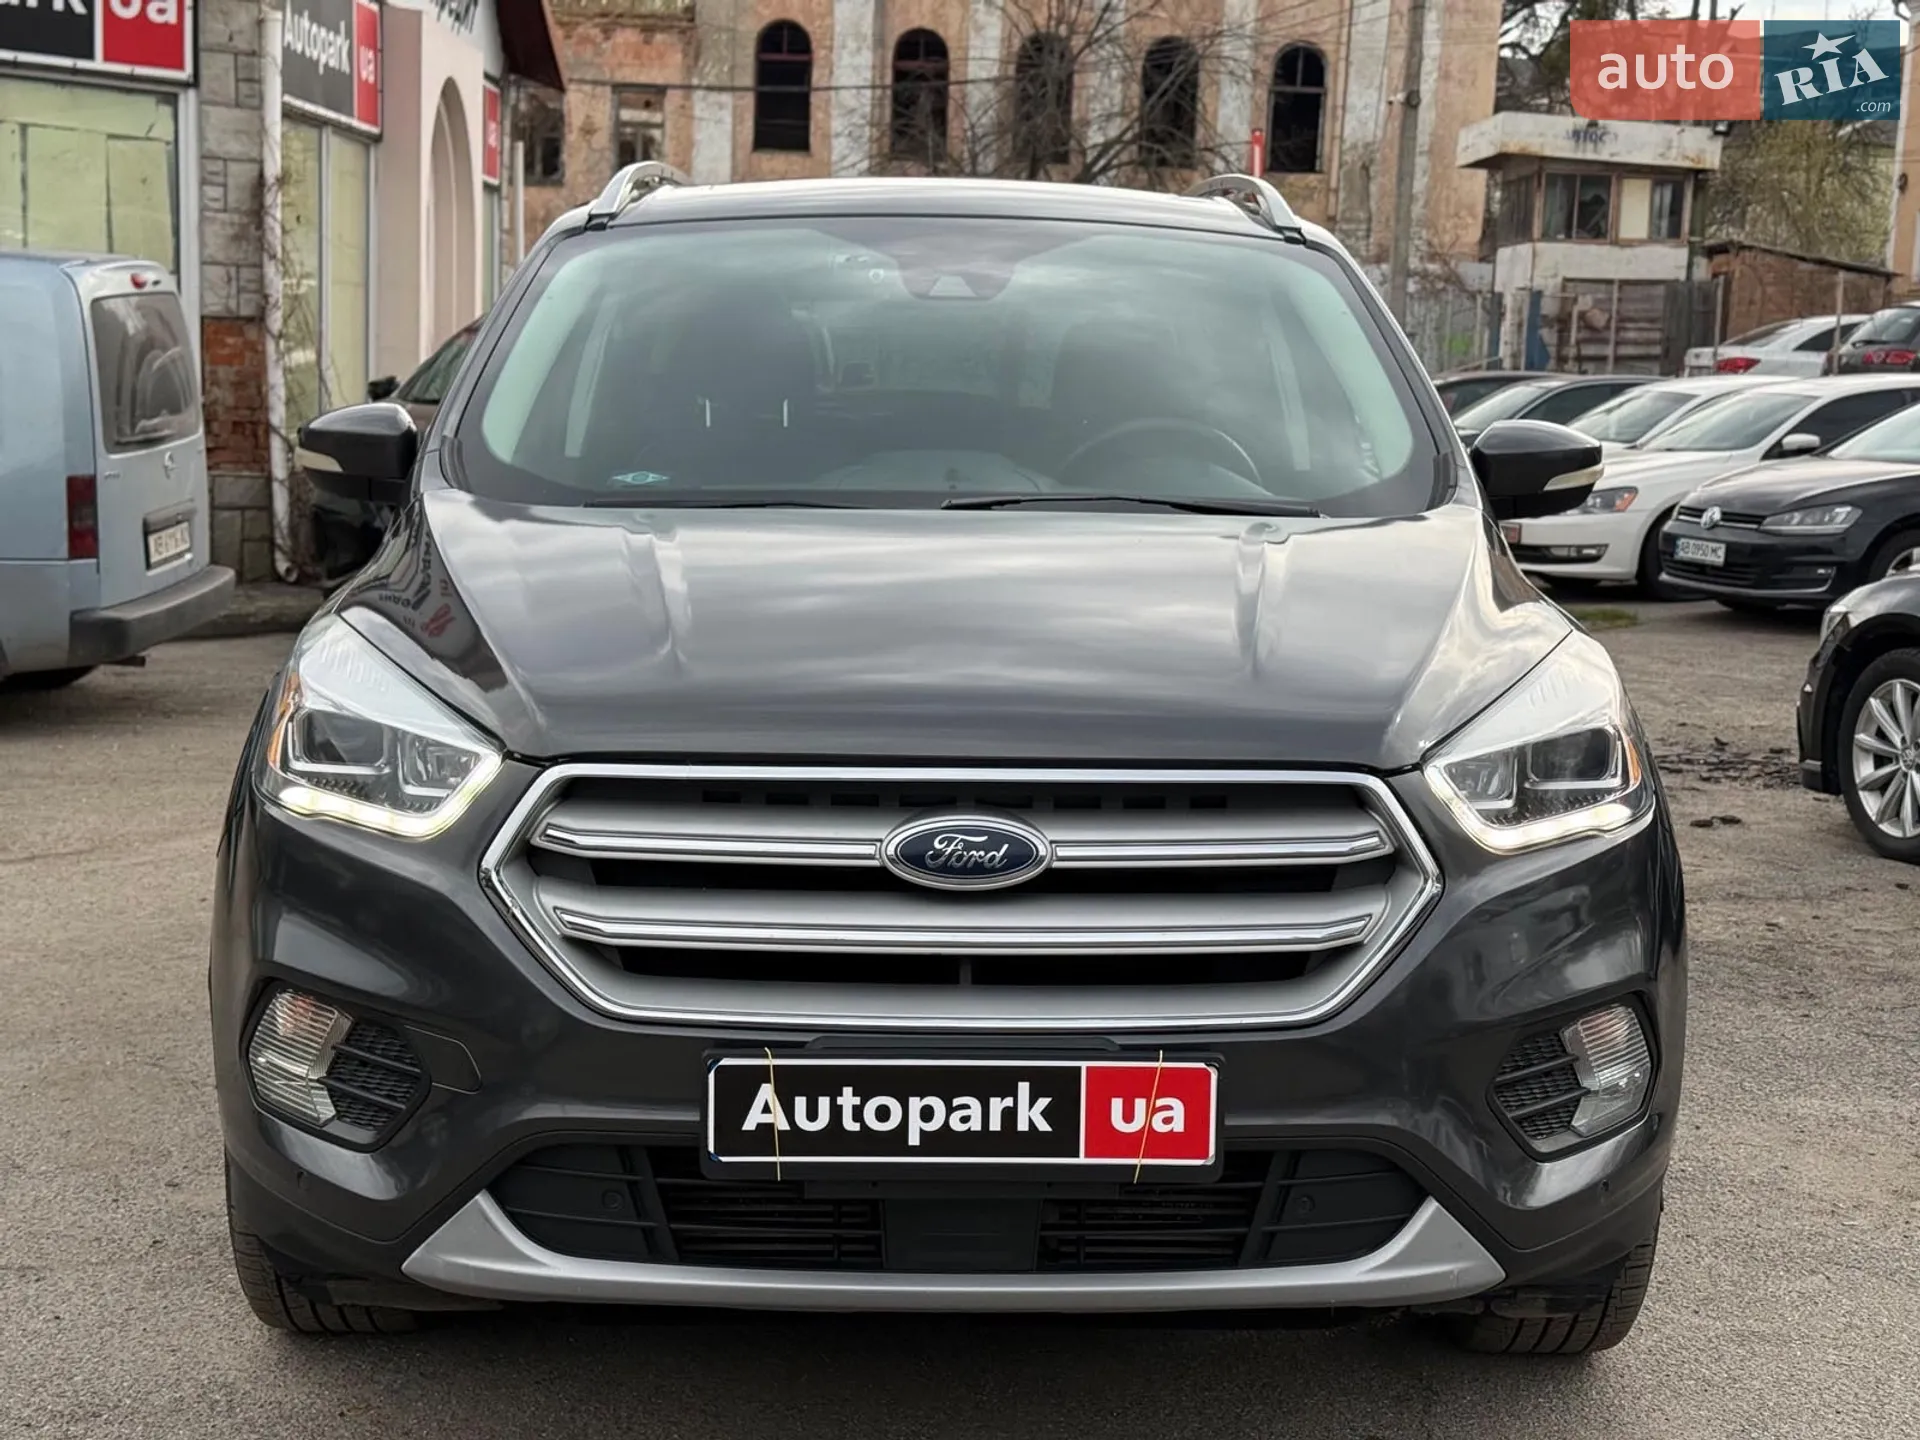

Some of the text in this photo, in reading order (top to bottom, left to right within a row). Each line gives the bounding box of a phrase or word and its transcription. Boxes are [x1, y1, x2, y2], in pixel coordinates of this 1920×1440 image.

[109, 0, 178, 25] ua
[284, 0, 375, 85] Autopark ua
[925, 833, 1009, 869] Ford
[741, 1081, 1186, 1147] Autopark ua
